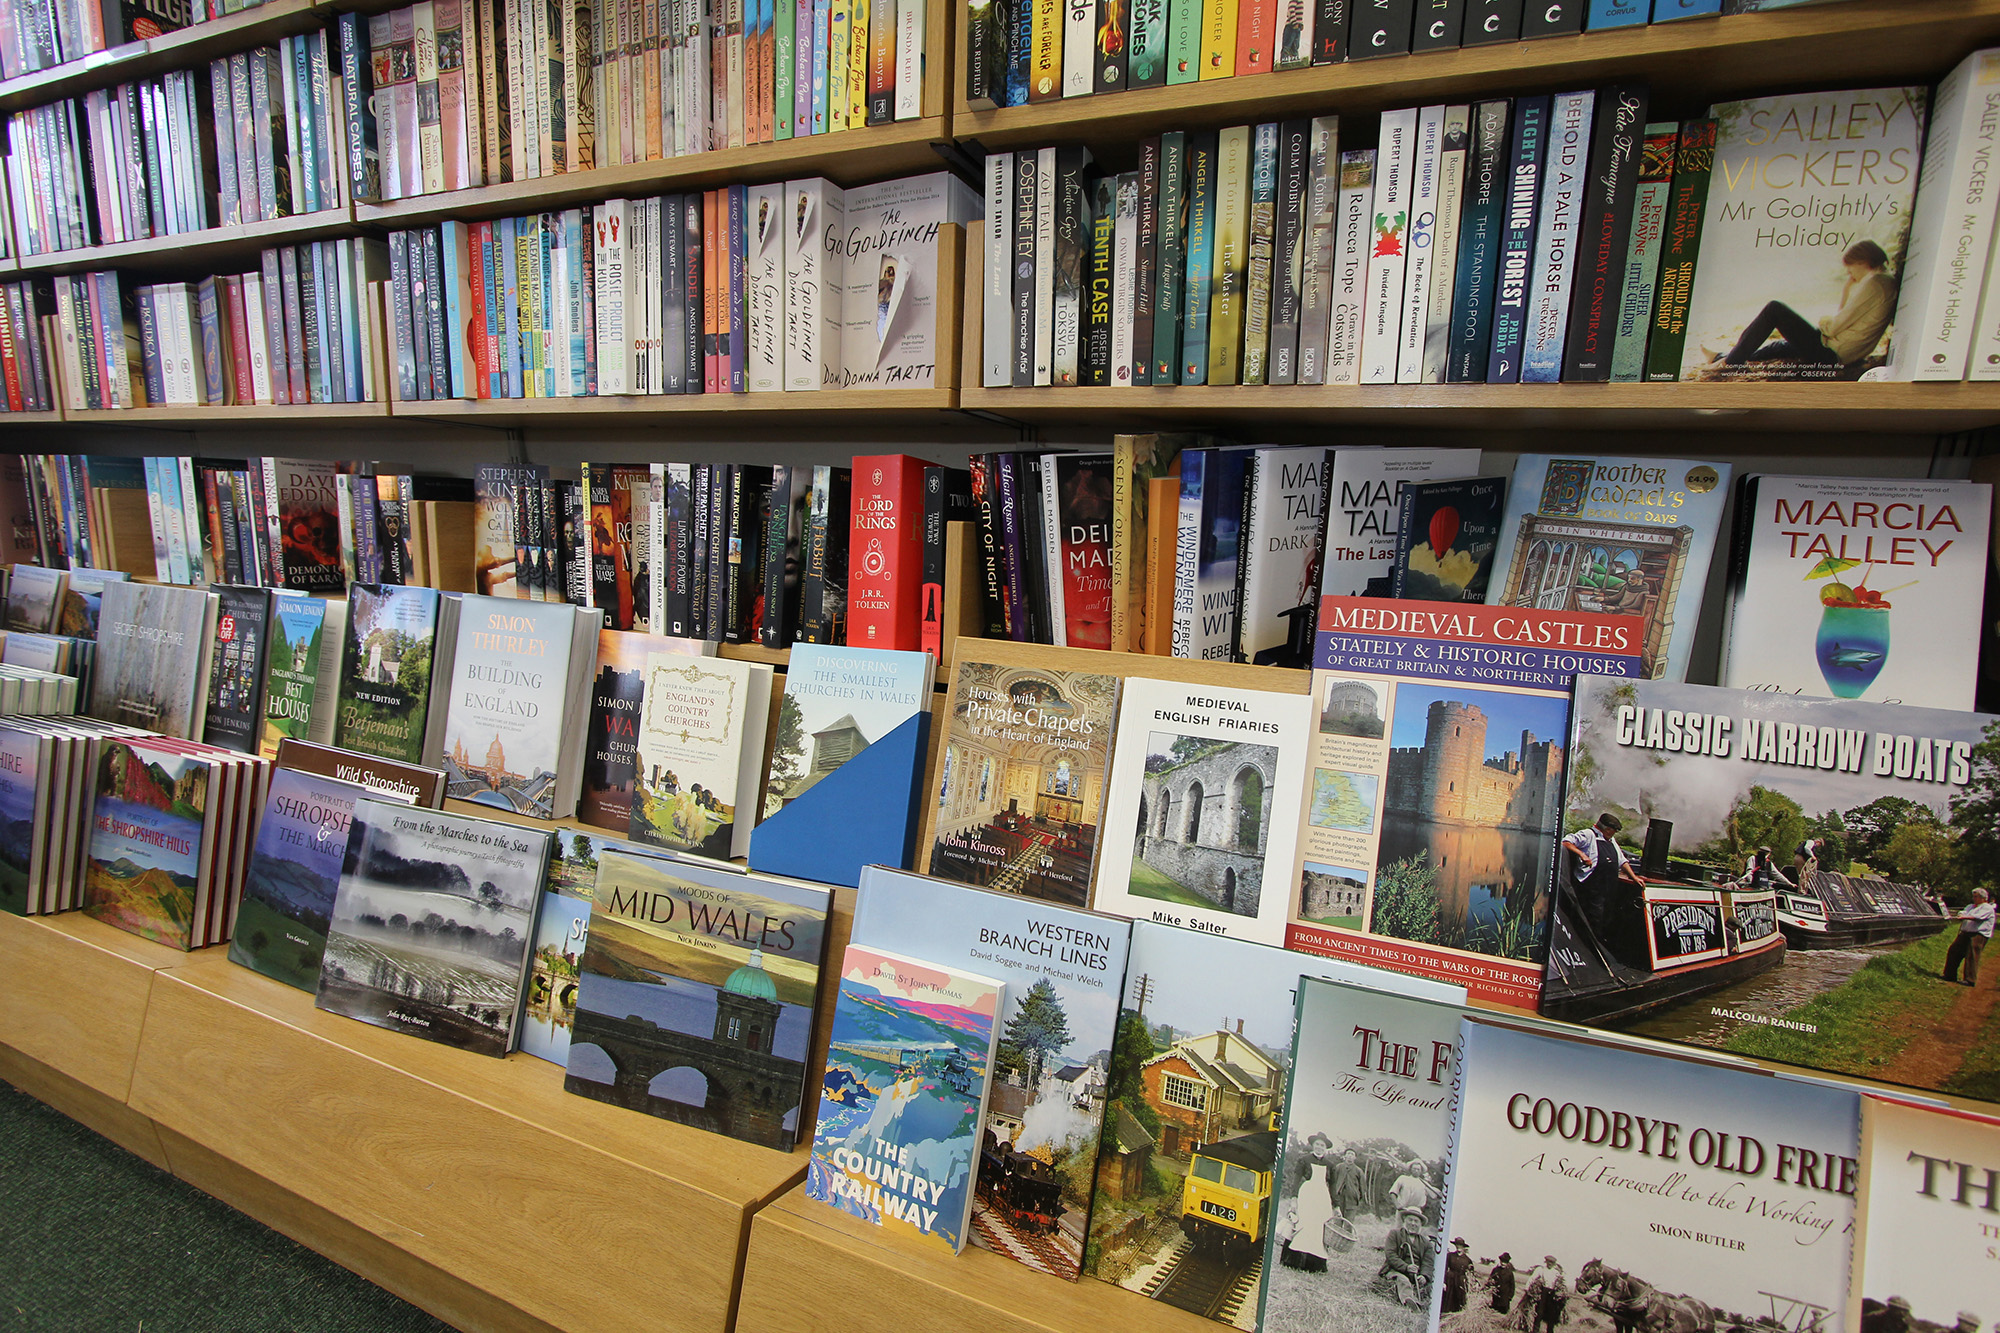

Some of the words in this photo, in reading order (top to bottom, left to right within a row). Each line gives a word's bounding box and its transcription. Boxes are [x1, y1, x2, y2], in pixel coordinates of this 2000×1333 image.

[852, 26, 865, 65] Barbara
[905, 11, 913, 55] BRENDA
[974, 20, 982, 48] JAMES
[1039, 30, 1052, 71] FOREVER
[852, 70, 865, 91] Pym
[974, 51, 982, 95] REDFIELD
[345, 54, 361, 121] NATURAL
[1482, 112, 1497, 152] ADAM
[1521, 108, 1540, 160] LIGHT
[1746, 101, 1903, 146] SALLEY
[350, 122, 363, 182] CAUSES
[1478, 155, 1493, 206] THORPE
[1722, 148, 1910, 192] VICKERS
[1018, 156, 1035, 232] JOSEPHINE
[1510, 163, 1536, 230] SHINING
[1719, 201, 1756, 222] Mr
[1766, 193, 1898, 223] Golightly's
[880, 208, 901, 227] The
[1475, 215, 1488, 240] THE
[668, 226, 676, 267] STEWART
[1018, 234, 1033, 258] TEY
[1094, 215, 1110, 272] TENTH
[1755, 224, 1855, 252] Holiday
[1468, 243, 1485, 307] STANDING
[1502, 250, 1527, 308] FOREST
[1092, 278, 1110, 325] CASE
[1464, 309, 1478, 344] POOL
[844, 367, 880, 388] DONNA
[885, 365, 935, 385] TARTT
[1800, 370, 1837, 378] OBSERVER
[1687, 475, 1716, 485] £4.99
[713, 487, 722, 512] TERRY
[859, 498, 893, 512] LORD
[1591, 485, 1686, 508] CADFAEL'S
[1868, 491, 1904, 500] Washington
[699, 491, 708, 541] PRATCHETT
[854, 514, 896, 530] RINGS
[981, 501, 992, 530] CITY
[1774, 498, 1963, 533] MARCIA
[711, 514, 722, 565] PRATCHETT
[984, 533, 995, 553] OF
[1538, 526, 1581, 535] ROBIN
[1589, 529, 1667, 542] WHITEMAN
[1781, 531, 1954, 567] TALLEY
[986, 557, 998, 600] NIGHT
[1182, 525, 1198, 614] WINDERMERE
[855, 600, 890, 610] TOLKIEN
[861, 589, 884, 598] J.R.R.
[279, 602, 301, 614] SIMON
[302, 605, 324, 617] JENKINS
[488, 614, 536, 633] SIMON
[113, 621, 138, 639] SECRET
[139, 627, 184, 647] SHROPSHIRE
[221, 617, 233, 631] £5
[221, 630, 233, 639] OFF
[1332, 607, 1485, 639] MEDIEVAL
[1492, 617, 1629, 650] CASTLES
[472, 631, 549, 657] THURLEY
[1328, 637, 1407, 657] STATELY
[1413, 644, 1431, 659] &
[1437, 645, 1536, 668] HISTORIC
[1542, 657, 1627, 676] HOUSES
[467, 664, 542, 689] BUILDING
[816, 656, 898, 674] DISCOVERING
[1327, 655, 1345, 666] OF
[1348, 656, 1393, 670] GREAT
[1395, 660, 1449, 675] BRITAIN
[1454, 664, 1466, 676] &
[1472, 667, 1554, 684] NORTHERN
[285, 681, 304, 699] BEST
[790, 682, 855, 699] CHURCHES
[860, 689, 874, 700] IN
[880, 691, 916, 705] WALES
[814, 670, 836, 683] THE
[842, 673, 898, 689] SMALLEST
[269, 695, 311, 723] HOUSES
[464, 692, 538, 718] ENGLAND
[598, 696, 634, 711] SIMON
[665, 691, 715, 707] ENGLAND'S
[969, 686, 1009, 702] Houses
[1013, 693, 1036, 706] with
[1186, 696, 1250, 712] MEDIEVAL
[343, 706, 409, 739] Betjeman's
[664, 715, 711, 730] CHURCHES
[668, 704, 709, 717] COUNTRY
[966, 701, 1022, 725] Private
[1024, 708, 1093, 736] Chapels
[1154, 710, 1210, 725] ENGLISH
[1219, 718, 1279, 733] FRIARIES
[971, 725, 979, 734] in
[984, 726, 999, 738] the
[1002, 729, 1030, 742] Heart
[1033, 733, 1045, 744] of
[1047, 735, 1090, 751] England
[1616, 705, 1731, 757] CLASSIC
[1740, 718, 1866, 773] NARROW
[1873, 732, 1972, 786] BOATS
[336, 764, 360, 784] Wild
[362, 771, 420, 797] Shropshire
[95, 815, 110, 832] THE
[111, 820, 165, 848] SHROPSHIRE
[166, 836, 190, 856] HILLS
[393, 816, 417, 831] From
[419, 821, 435, 834] the
[437, 824, 479, 843] Marches
[481, 835, 491, 845] to
[493, 835, 509, 848] the
[510, 839, 528, 852] Sea
[644, 829, 686, 845] CHRISTOPHER
[687, 839, 705, 849] WINN
[946, 835, 967, 849] John
[971, 839, 1006, 856] Kinross
[677, 886, 714, 900] MOODS
[716, 892, 730, 903] OF
[1794, 902, 1820, 914] KILDARE
[609, 886, 674, 924] MID
[688, 901, 796, 951] WALES
[1153, 911, 1181, 925] Mike
[1190, 918, 1227, 934] Salter
[1662, 905, 1716, 938] PRESIDENT
[693, 938, 717, 949] JENKINS
[979, 928, 1053, 958] BRANCH
[1060, 947, 1107, 970] LINES
[1027, 919, 1110, 951] WESTERN
[970, 949, 992, 960] David
[995, 954, 1022, 968] Soggee
[1025, 963, 1040, 973] and
[1043, 966, 1073, 981] Michael
[1077, 974, 1103, 988] Welch
[873, 967, 896, 981] DAVID
[898, 974, 908, 984] ST
[910, 977, 929, 991] JOHN
[930, 983, 962, 1000] THOMAS
[1711, 1007, 1767, 1025] MALCOLM
[1770, 1017, 1818, 1033] RANIERI
[875, 1138, 908, 1166] THE
[1507, 1092, 1679, 1161] GOODBYE
[1688, 1127, 1765, 1176] OLD
[1772, 1143, 1857, 1197] FRIE
[833, 1147, 945, 1207] COUNTRY
[831, 1171, 939, 1232] RAILWAY
[1203, 1202, 1236, 1222] 1A28
[1521, 1152, 1546, 1172] A
[1551, 1157, 1589, 1182] Sad
[1592, 1156, 1688, 1199] Farewell
[1681, 1185, 1704, 1203] to
[1707, 1181, 1746, 1211] the
[1746, 1196, 1835, 1246] Working
[1649, 1222, 1692, 1241] SIMON
[1695, 1232, 1746, 1251] BUTLER
